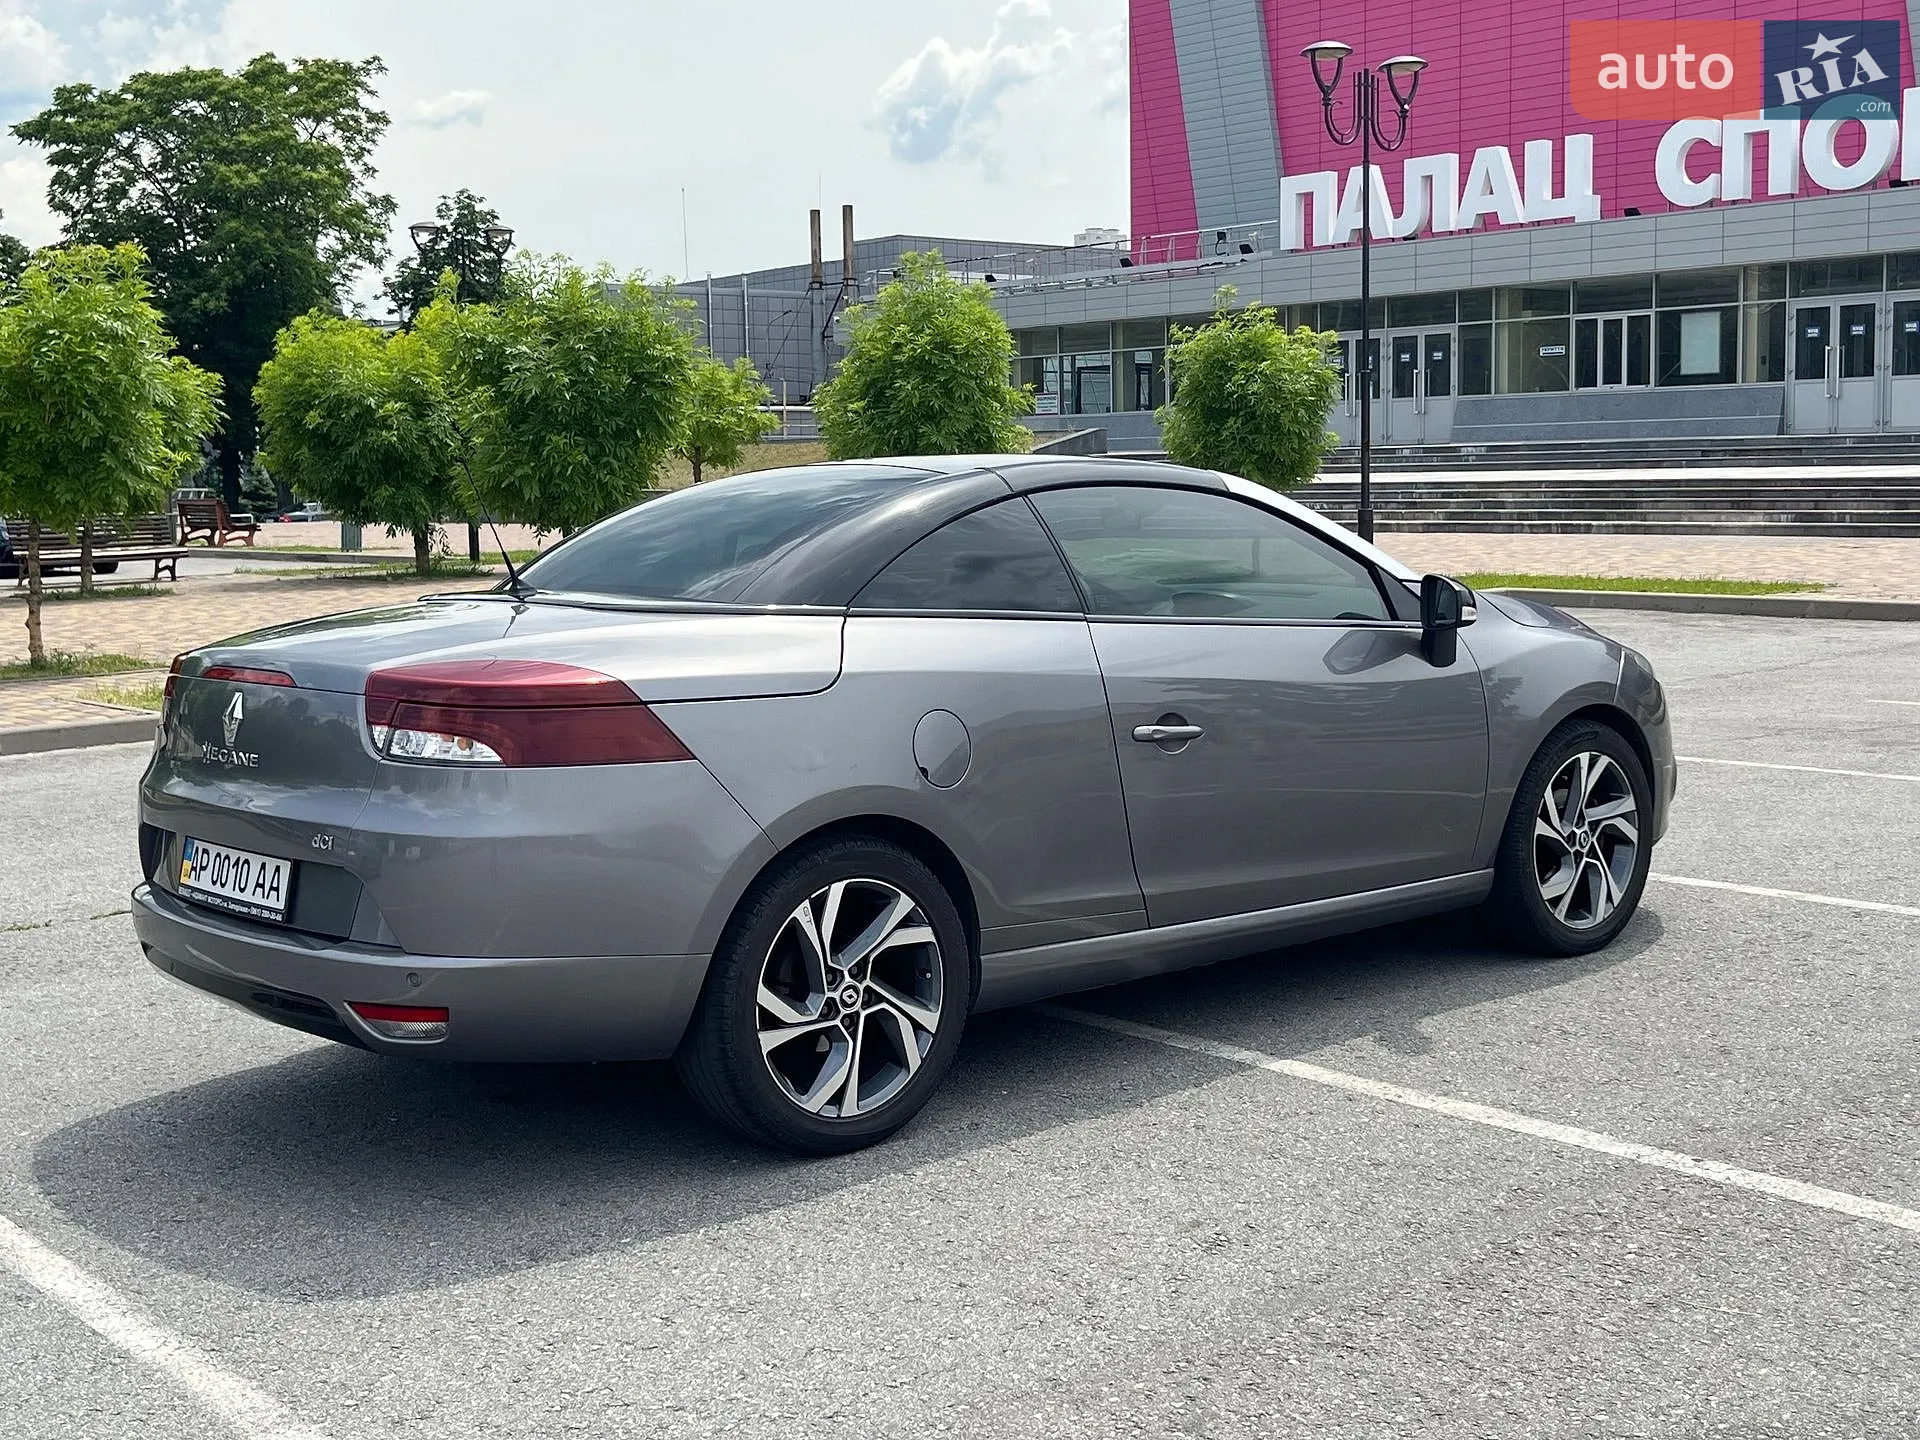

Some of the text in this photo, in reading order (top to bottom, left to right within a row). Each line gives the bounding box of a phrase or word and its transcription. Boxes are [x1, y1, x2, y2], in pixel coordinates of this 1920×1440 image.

[1280, 87, 1920, 250] ПАЛАЦ СПО
[201, 741, 259, 768] MEGANE
[188, 846, 210, 882] AP
[211, 852, 251, 893] 0010
[252, 862, 281, 902] AA
